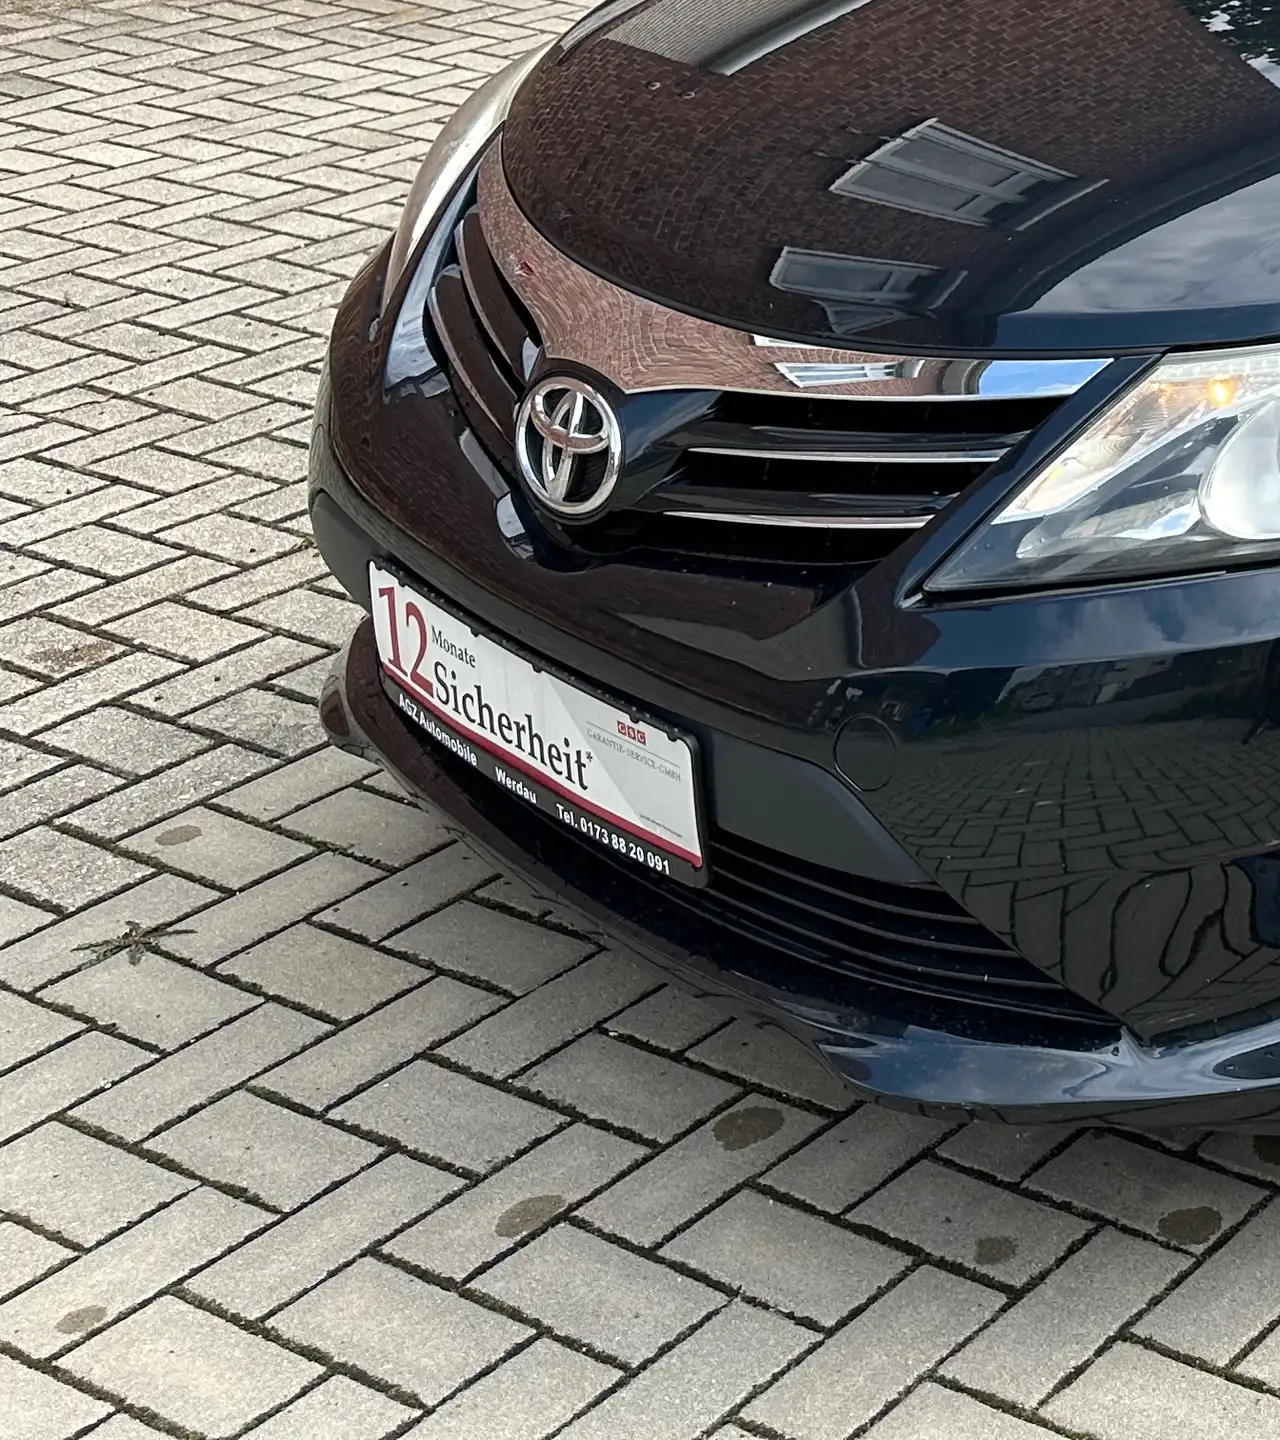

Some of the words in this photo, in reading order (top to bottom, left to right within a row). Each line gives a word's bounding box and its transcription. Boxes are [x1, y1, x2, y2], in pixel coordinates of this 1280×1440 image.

[378, 587, 435, 699] 12
[431, 625, 476, 668] Monate
[399, 692, 420, 721] AGZ
[419, 713, 477, 766] Automobile
[495, 766, 537, 804] Werdau
[556, 803, 578, 828] Tel.
[580, 817, 609, 844] 0173
[611, 834, 626, 853] 88
[629, 844, 644, 862] 20
[647, 852, 670, 875] 091
